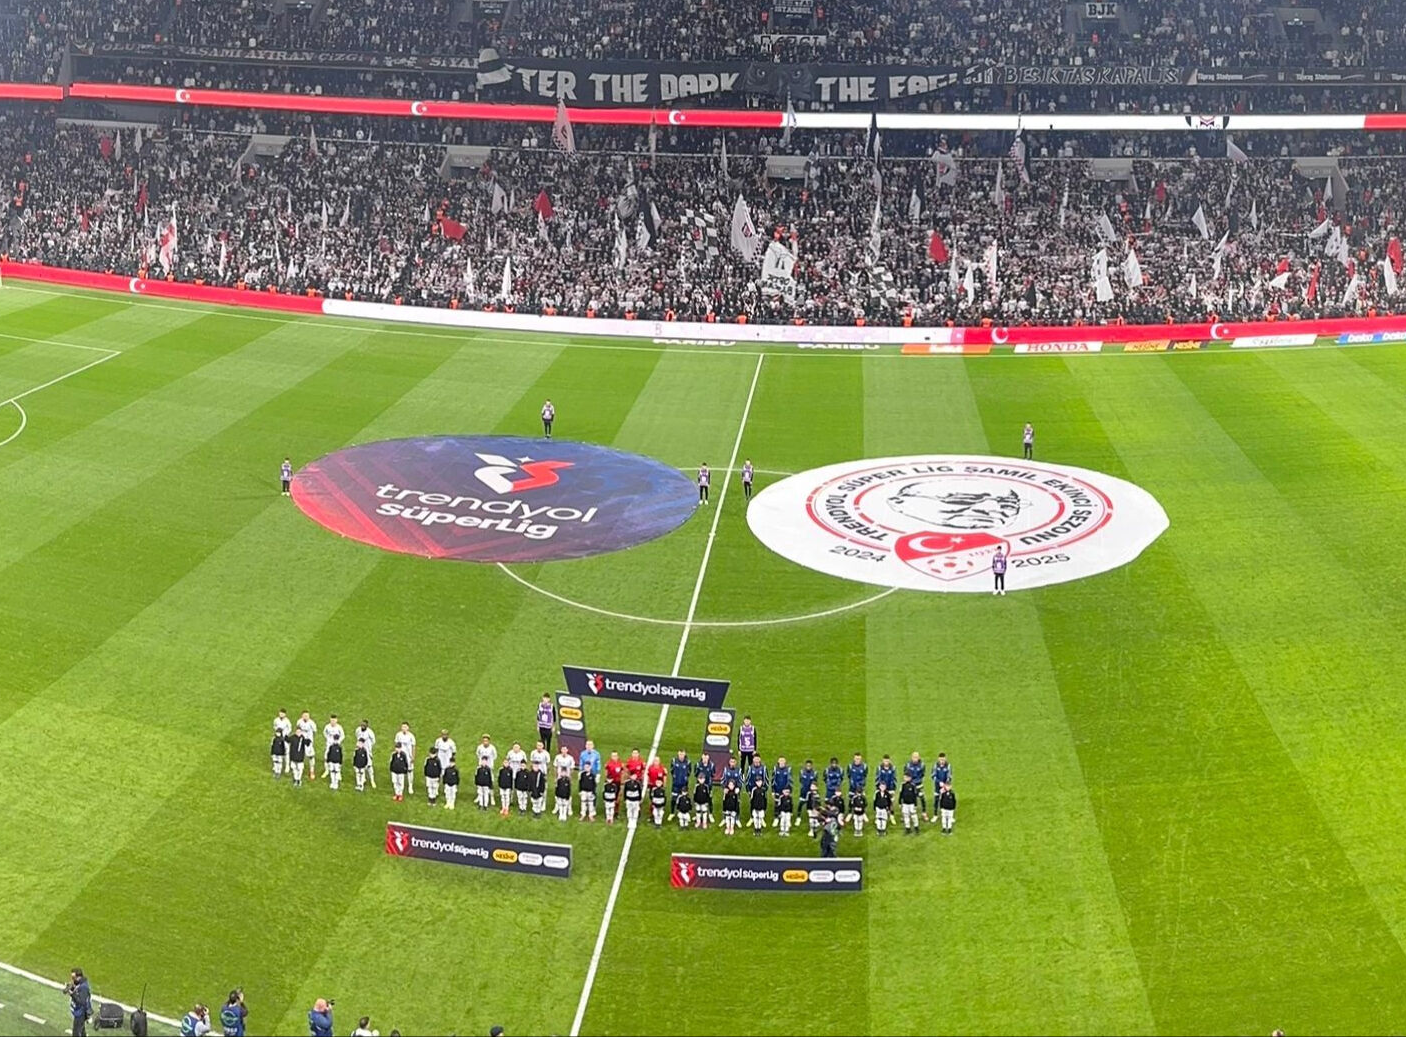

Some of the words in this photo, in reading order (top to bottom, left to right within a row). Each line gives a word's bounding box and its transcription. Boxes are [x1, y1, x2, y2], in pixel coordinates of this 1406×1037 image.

[516, 68, 577, 100] TER
[588, 73, 648, 102] THE
[815, 76, 878, 102] THE
[1027, 342, 1089, 352] HONDA
[838, 469, 907, 492] SÜPER
[1043, 478, 1098, 508] EKİNCİ
[375, 483, 598, 523] trendyol
[826, 494, 889, 542] TRENDYOL
[1020, 509, 1092, 545] SEZONU
[829, 545, 886, 564] 2024
[1011, 553, 1071, 568] 2025
